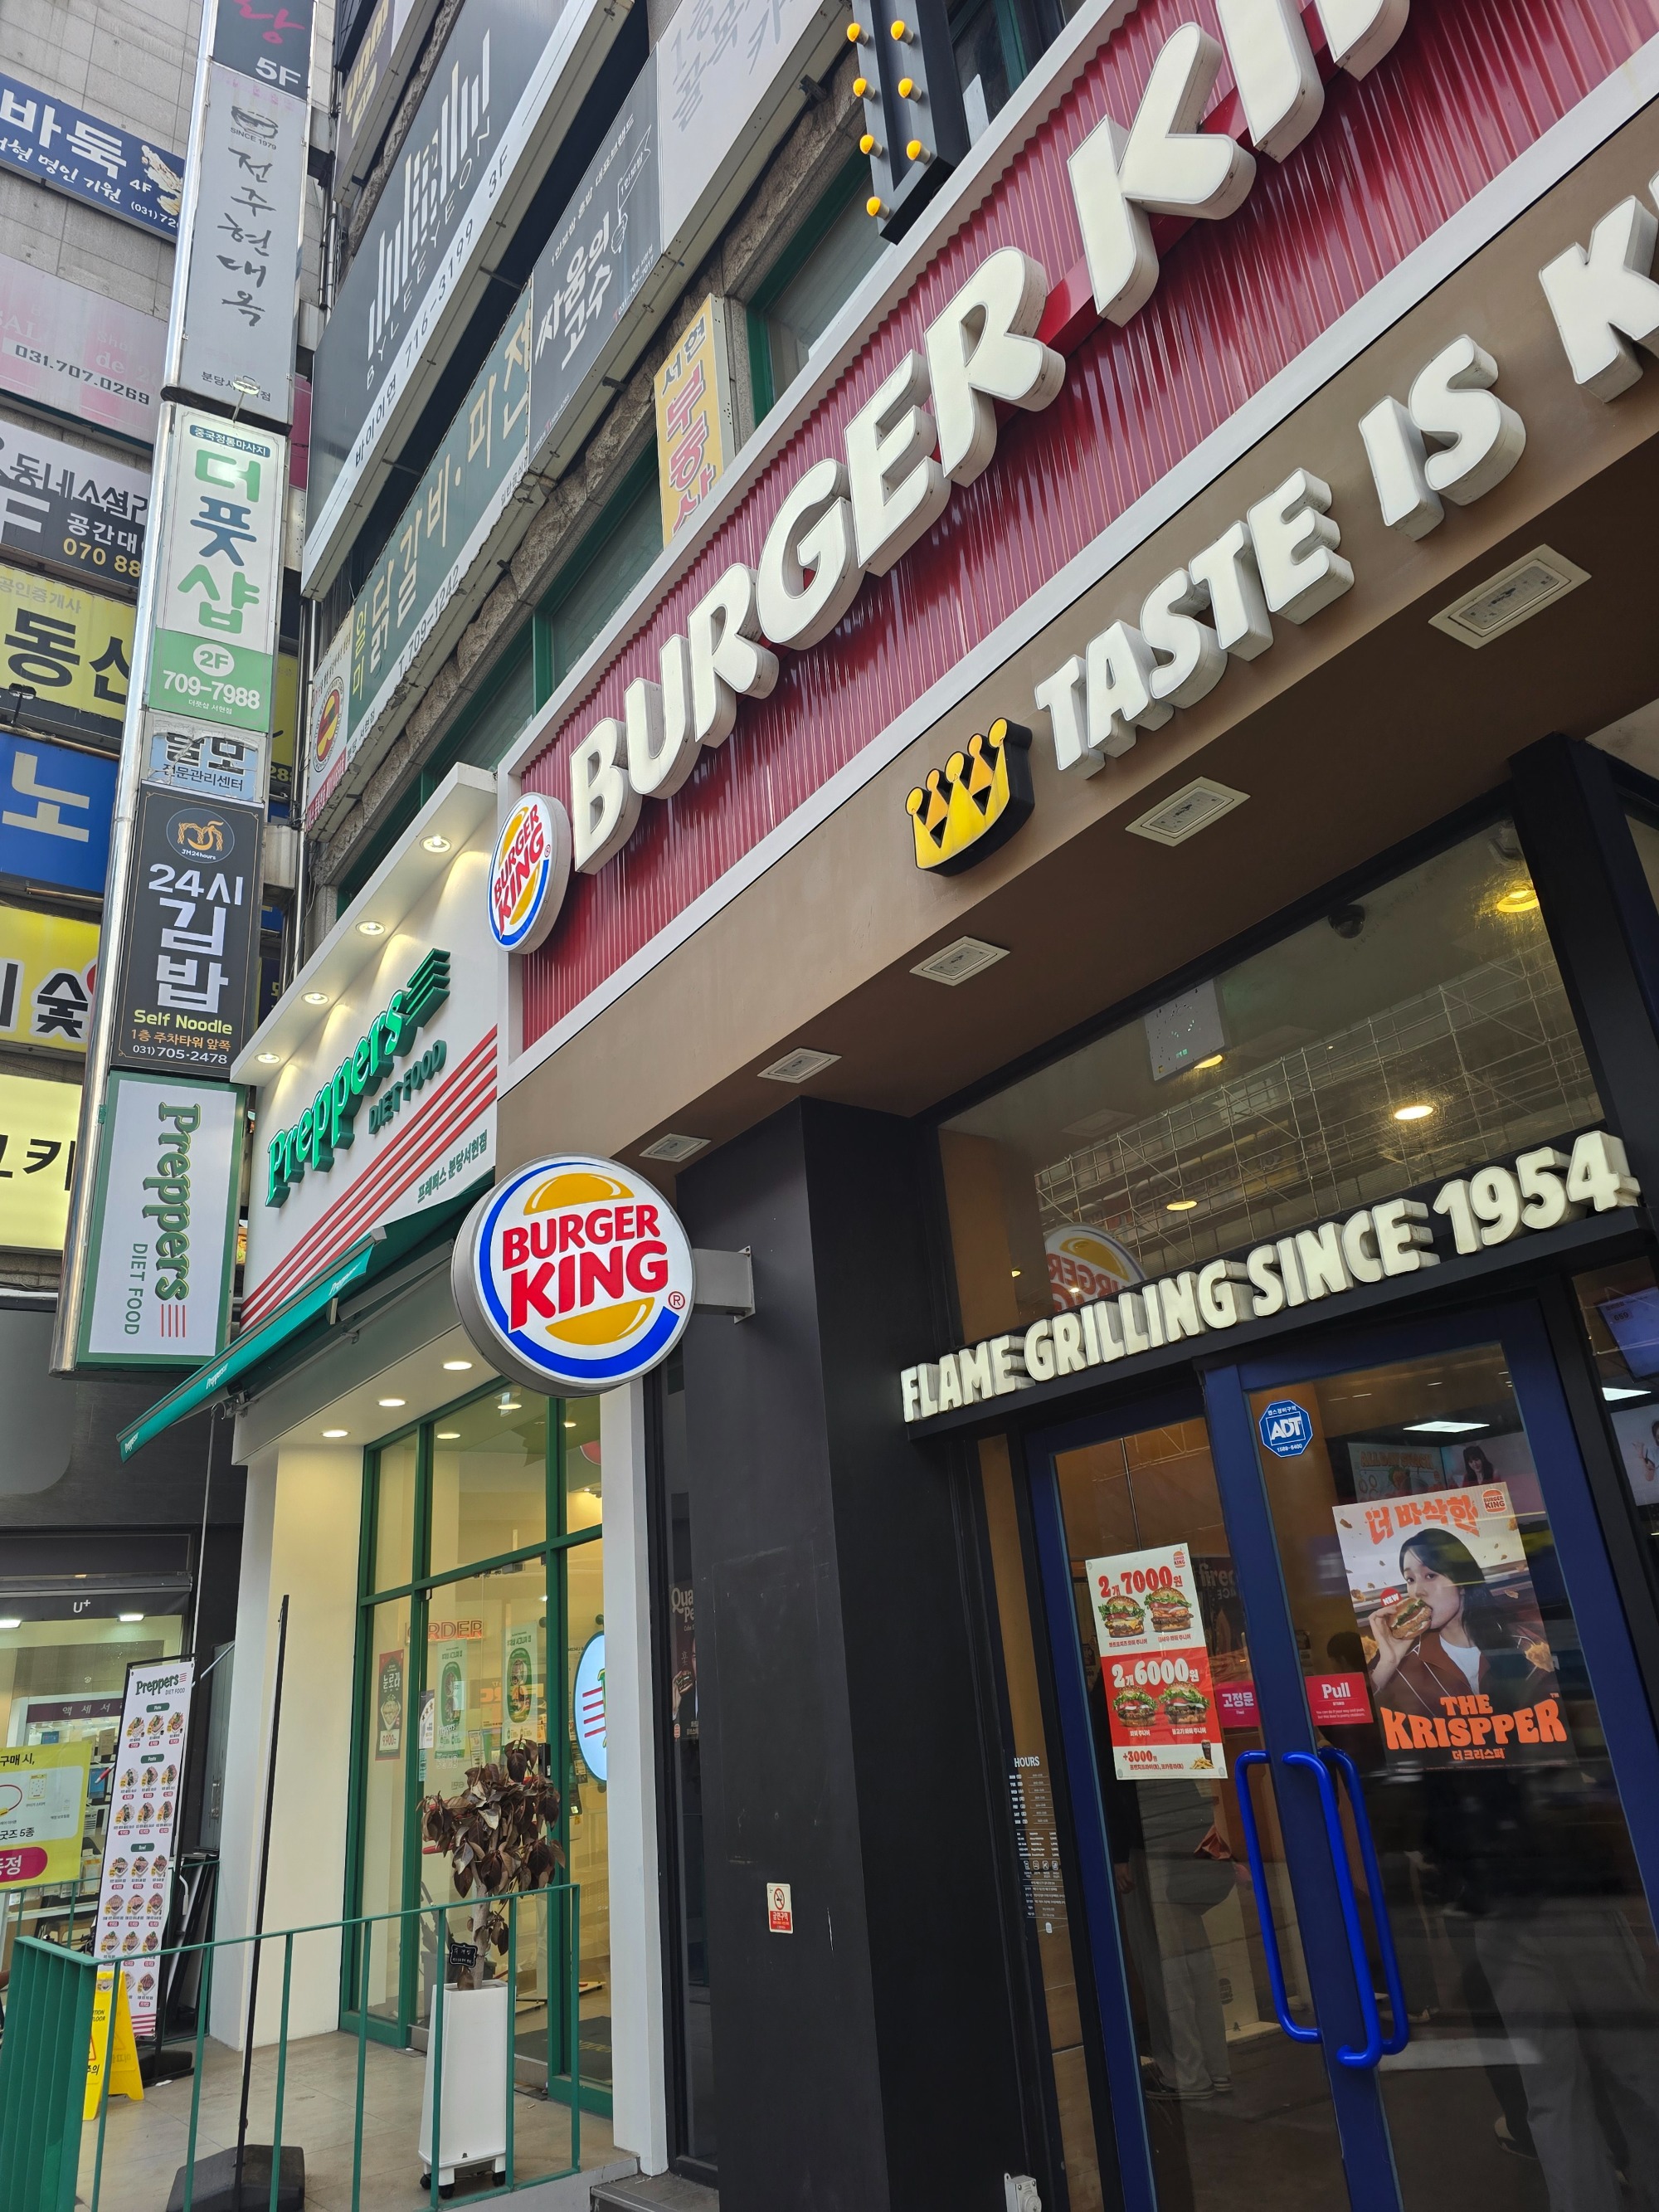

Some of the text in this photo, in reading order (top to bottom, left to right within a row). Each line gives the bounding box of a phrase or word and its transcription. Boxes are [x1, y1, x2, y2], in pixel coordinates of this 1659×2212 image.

[255, 56, 301, 86] 5F
[0, 89, 127, 180] 바둑
[230, 127, 277, 151] SINCE 1979
[38, 154, 79, 183] 명인
[84, 178, 121, 204] 기원
[129, 179, 152, 193] 4F
[131, 201, 180, 229] (031) 72
[217, 147, 277, 327] 전주현대옥
[367, 115, 491, 390] BYLEEYEON
[404, 218, 474, 370] 716-3199
[488, 144, 509, 200] 3F
[534, 211, 610, 365] 싸움의
[562, 264, 613, 371] 고수
[15, 344, 150, 406] 031.707.0269
[661, 314, 706, 396] 서현
[193, 427, 267, 456] 중국정통마사지
[1034, 173, 1659, 779] TASTE IS K
[63, 538, 106, 565] 070
[66, 512, 145, 554] 공간대
[177, 449, 261, 634] 더풋샵
[570, 246, 1066, 874] BURGER
[199, 650, 229, 669] 2F
[163, 670, 260, 709] 709-7988
[2, 751, 90, 843] 노
[161, 763, 244, 792] 전문관리센터
[494, 803, 540, 908] BURGER
[148, 863, 244, 906] 24시
[498, 821, 545, 939] KING
[156, 897, 229, 1014] 김밥
[134, 1008, 233, 1035] Self Noodle
[153, 1031, 204, 1050] 주차타워
[207, 1039, 232, 1053] 앞쪽
[265, 988, 416, 1208] Preppers
[368, 1039, 448, 1135] DIET FOOD
[417, 1129, 488, 1204] 프레퍼스 분당서현점
[143, 1102, 202, 1302] Preppers
[502, 1205, 661, 1271] BURGER
[124, 1243, 148, 1336] DIET FOOD
[510, 1240, 669, 1331] KING
[901, 1129, 1640, 1423] FLAME GRILLING SINCE 1954
[1271, 1416, 1301, 1440] ADT
[1365, 1494, 1481, 1545] 더 바삭한
[1483, 1495, 1505, 1504] BURGER
[1484, 1500, 1506, 1509] KING
[1098, 1576, 1121, 1598] 2개
[1121, 1566, 1184, 1595] 7000원
[1383, 1593, 1399, 1605] NEW
[73, 1599, 91, 1613] U+
[407, 1620, 483, 1640] RDER
[135, 1674, 179, 1696] Preppers
[1112, 1658, 1199, 1688] 2개 6000원
[1321, 1682, 1351, 1699] Pull
[62, 1703, 123, 1716] 액세서
[1222, 1692, 1254, 1708] 고정문
[1440, 1694, 1493, 1717] THE
[1380, 1698, 1568, 1750] KRISPPER
[0, 1752, 36, 1767] 구매 시,
[1014, 1756, 1040, 1768] HOURS
[20, 1826, 35, 1839] 5종
